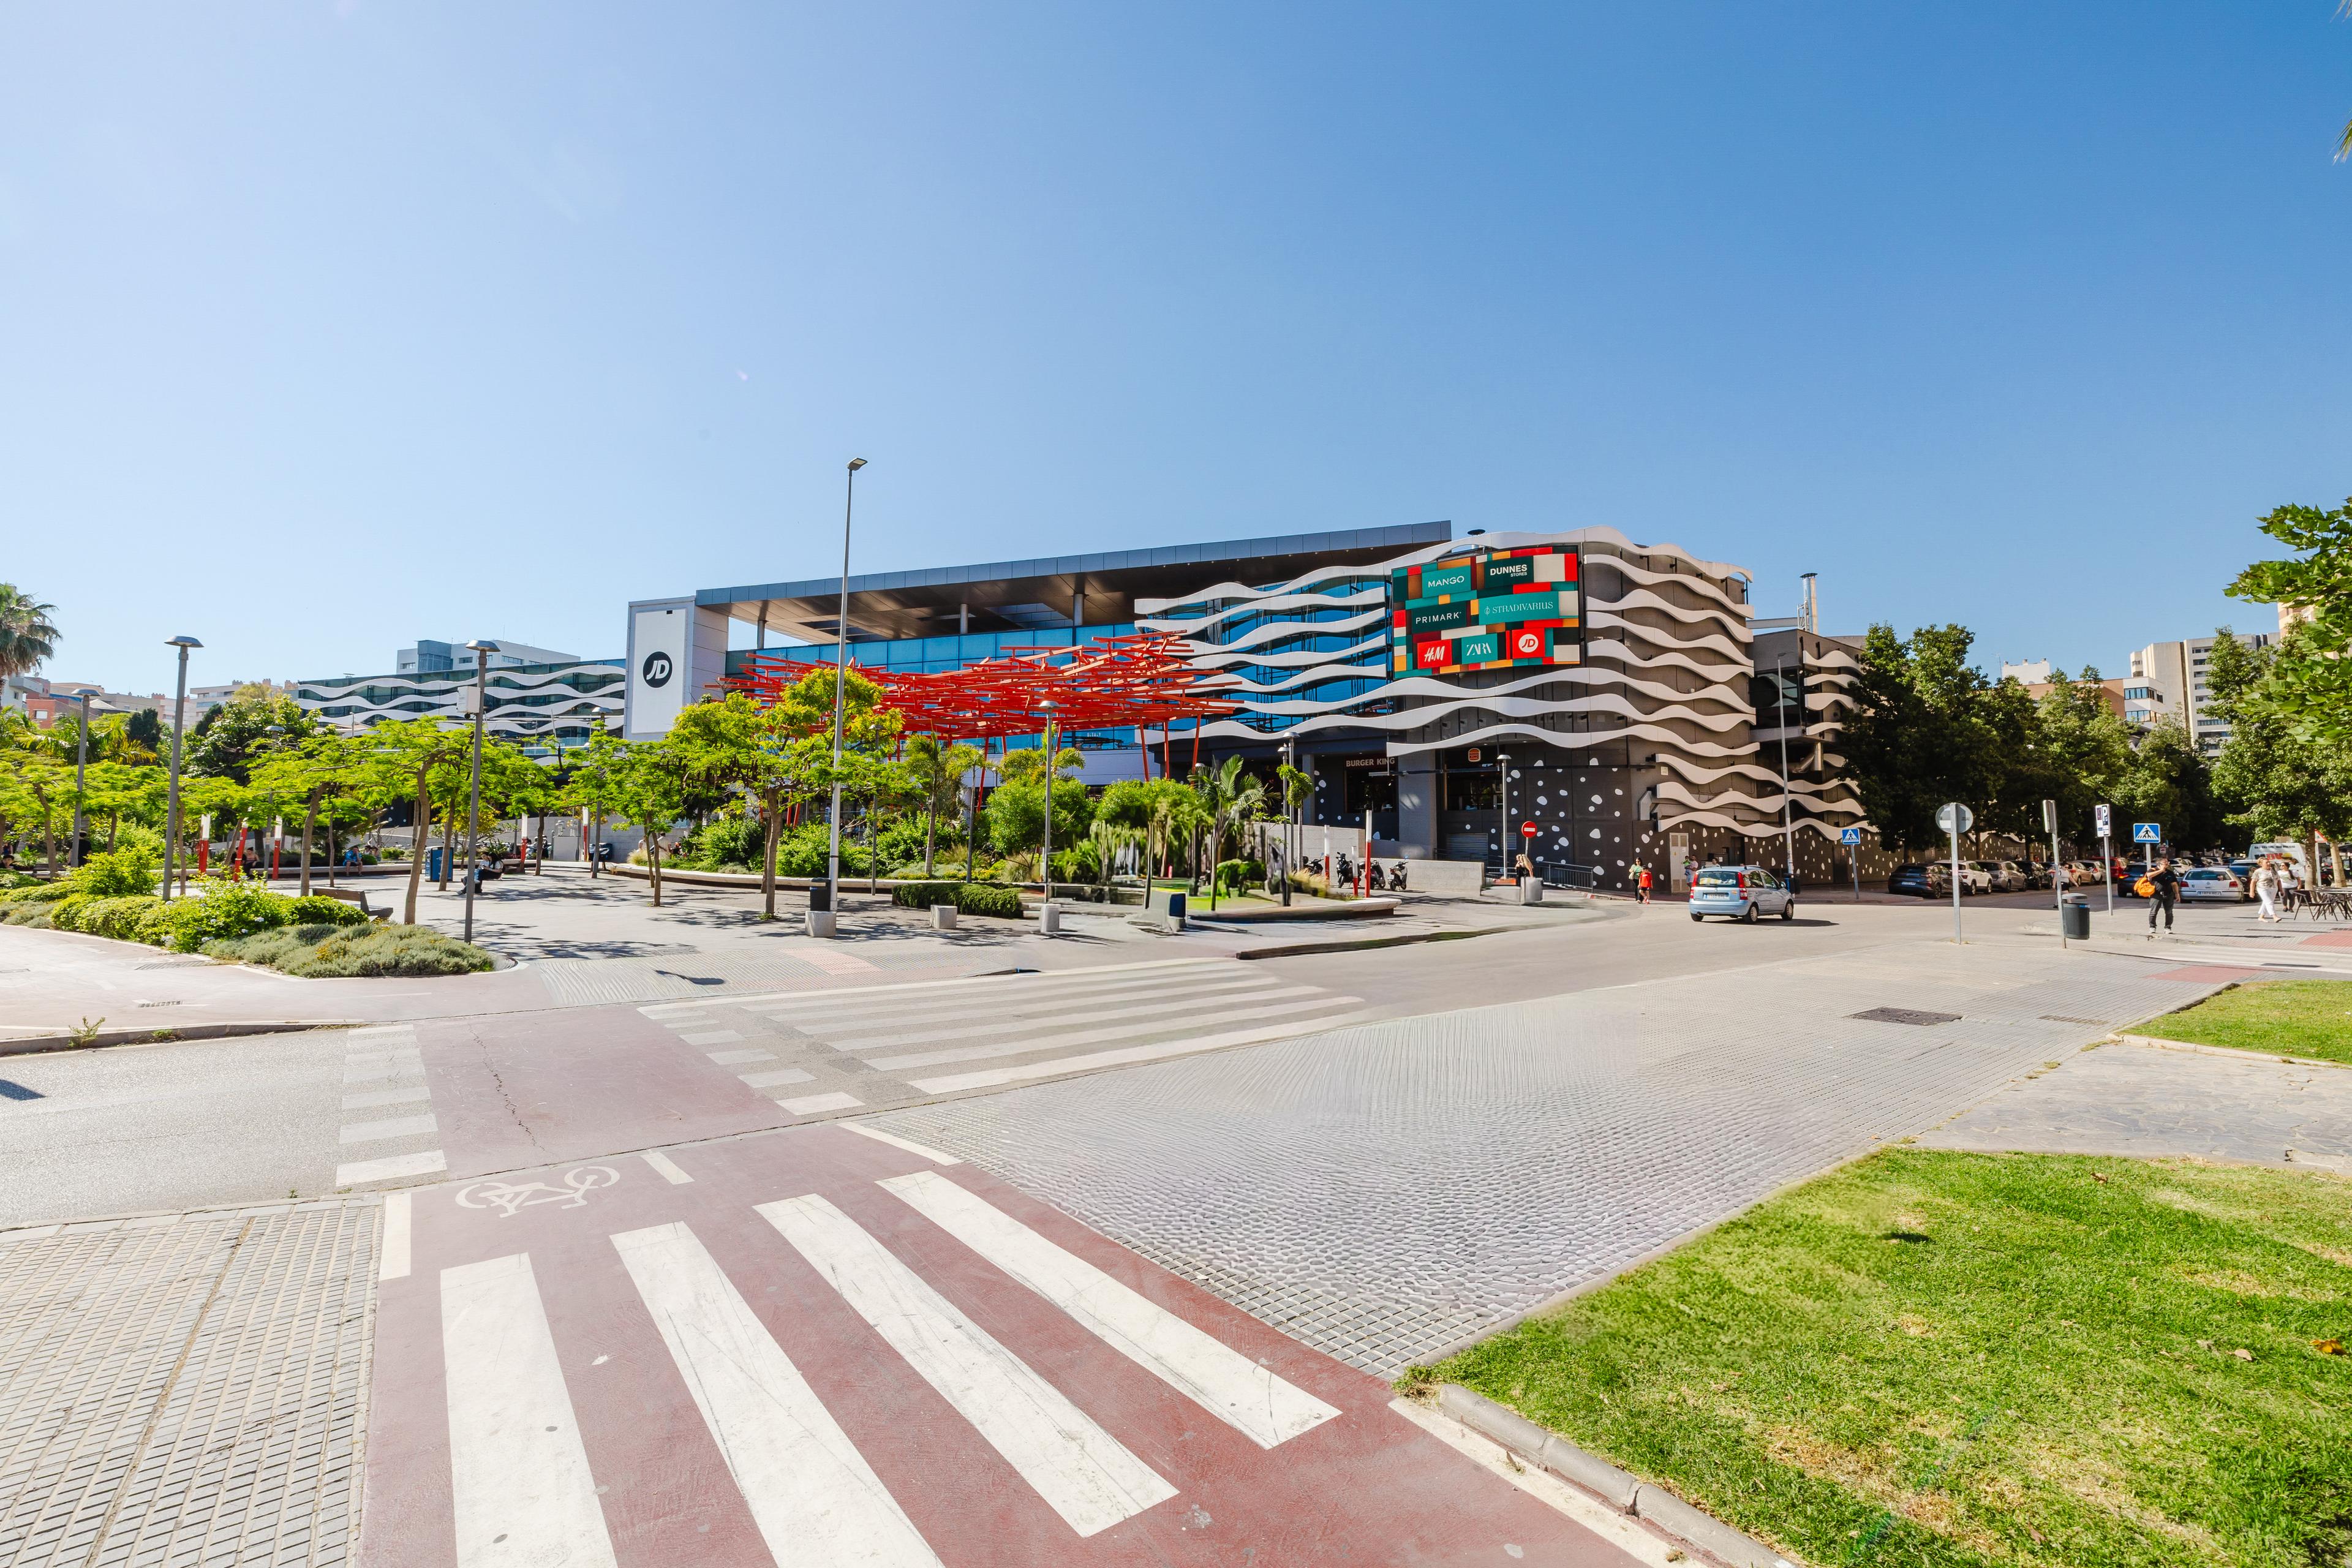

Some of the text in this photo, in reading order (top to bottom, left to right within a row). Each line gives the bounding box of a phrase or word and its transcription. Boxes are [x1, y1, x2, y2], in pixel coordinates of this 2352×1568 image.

[1490, 564, 1528, 576] DUNNES
[1428, 575, 1464, 588] MANGO
[1492, 601, 1553, 614] STRADIVARIUS
[1415, 611, 1460, 625] PRIMARK
[1466, 642, 1492, 656] ZARA
[1521, 638, 1536, 649] JD
[1424, 646, 1446, 662] H&M
[646, 660, 669, 680] JD
[1346, 757, 1395, 767] BURGER KING
